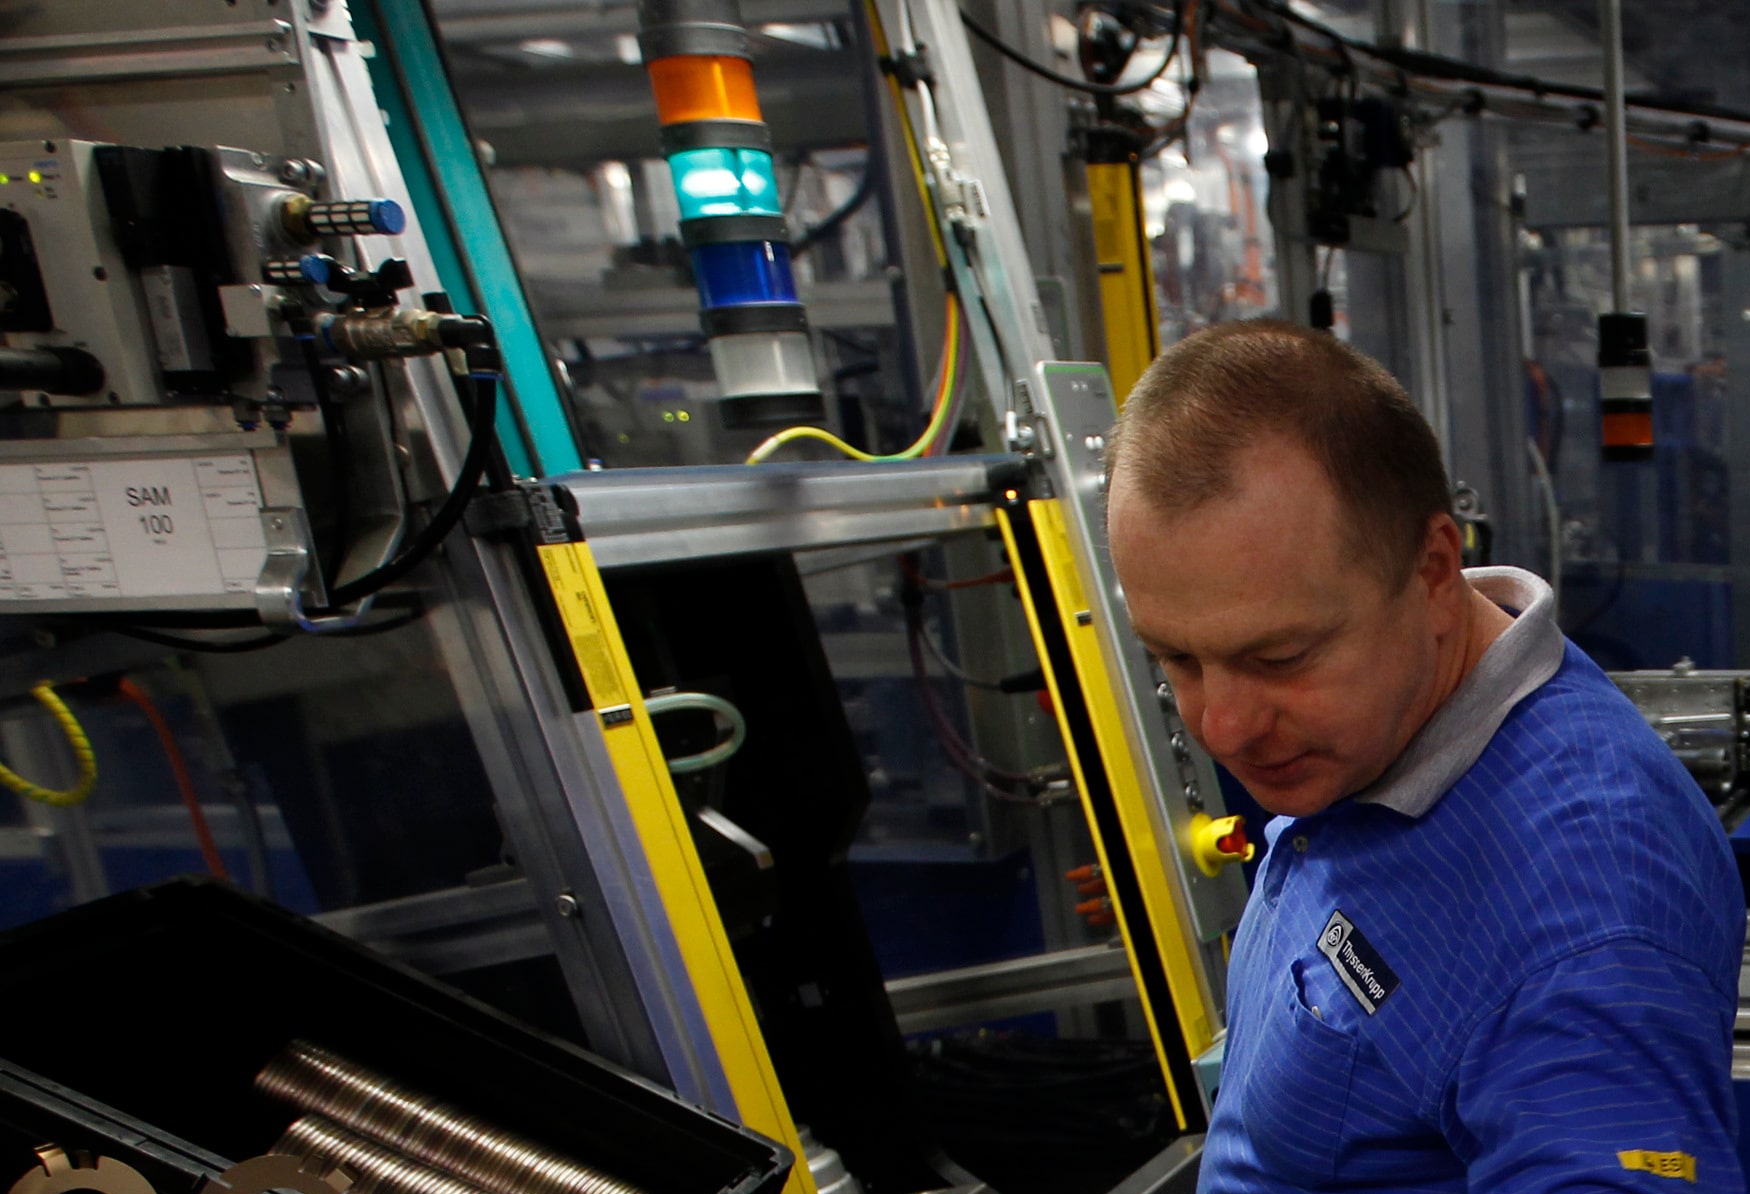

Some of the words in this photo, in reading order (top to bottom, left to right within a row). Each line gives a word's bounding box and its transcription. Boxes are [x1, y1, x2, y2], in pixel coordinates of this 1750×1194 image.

[126, 486, 172, 507] SAM
[139, 515, 174, 535] 100
[1341, 940, 1385, 1000] ThyssenKrupp
